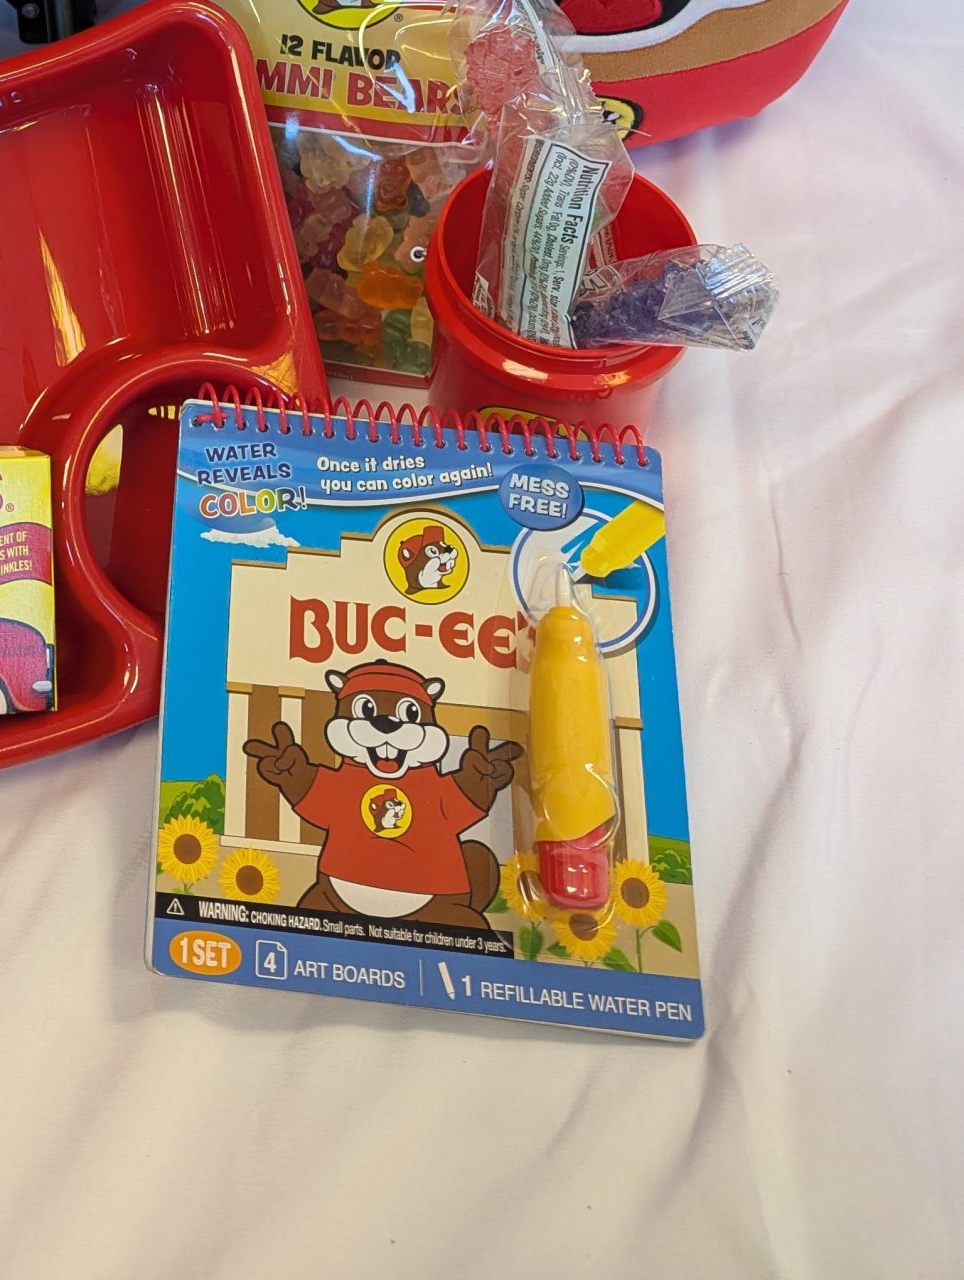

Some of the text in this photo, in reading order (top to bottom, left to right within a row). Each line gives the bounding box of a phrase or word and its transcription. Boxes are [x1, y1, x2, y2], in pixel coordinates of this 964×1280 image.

[279, 33, 401, 70] 12 FLAVOR
[256, 58, 334, 100] MMI
[540, 185, 554, 209] Added
[555, 189, 570, 208] Trans
[568, 165, 600, 210] Nutrition
[561, 213, 584, 244] Facts
[205, 442, 277, 462] WATER
[317, 455, 425, 472] Once it dries
[197, 463, 291, 485] REVEALS
[320, 462, 494, 495] you can color again!
[509, 473, 570, 499] MESS
[199, 486, 307, 518] COLOR!
[508, 493, 568, 519] FREE!
[6, 545, 29, 558] WITH
[16, 531, 28, 542] OF
[289, 595, 536, 670] BUC-EE'
[198, 900, 507, 954] WARNING: CHOKING HAZARD. Small parts. Not suitable for children under 3 years.
[180, 937, 232, 969] 1 SET
[263, 951, 406, 989] 4 ART BOARDS
[461, 975, 693, 1022] 1 REFILLABLE WATER PEN
